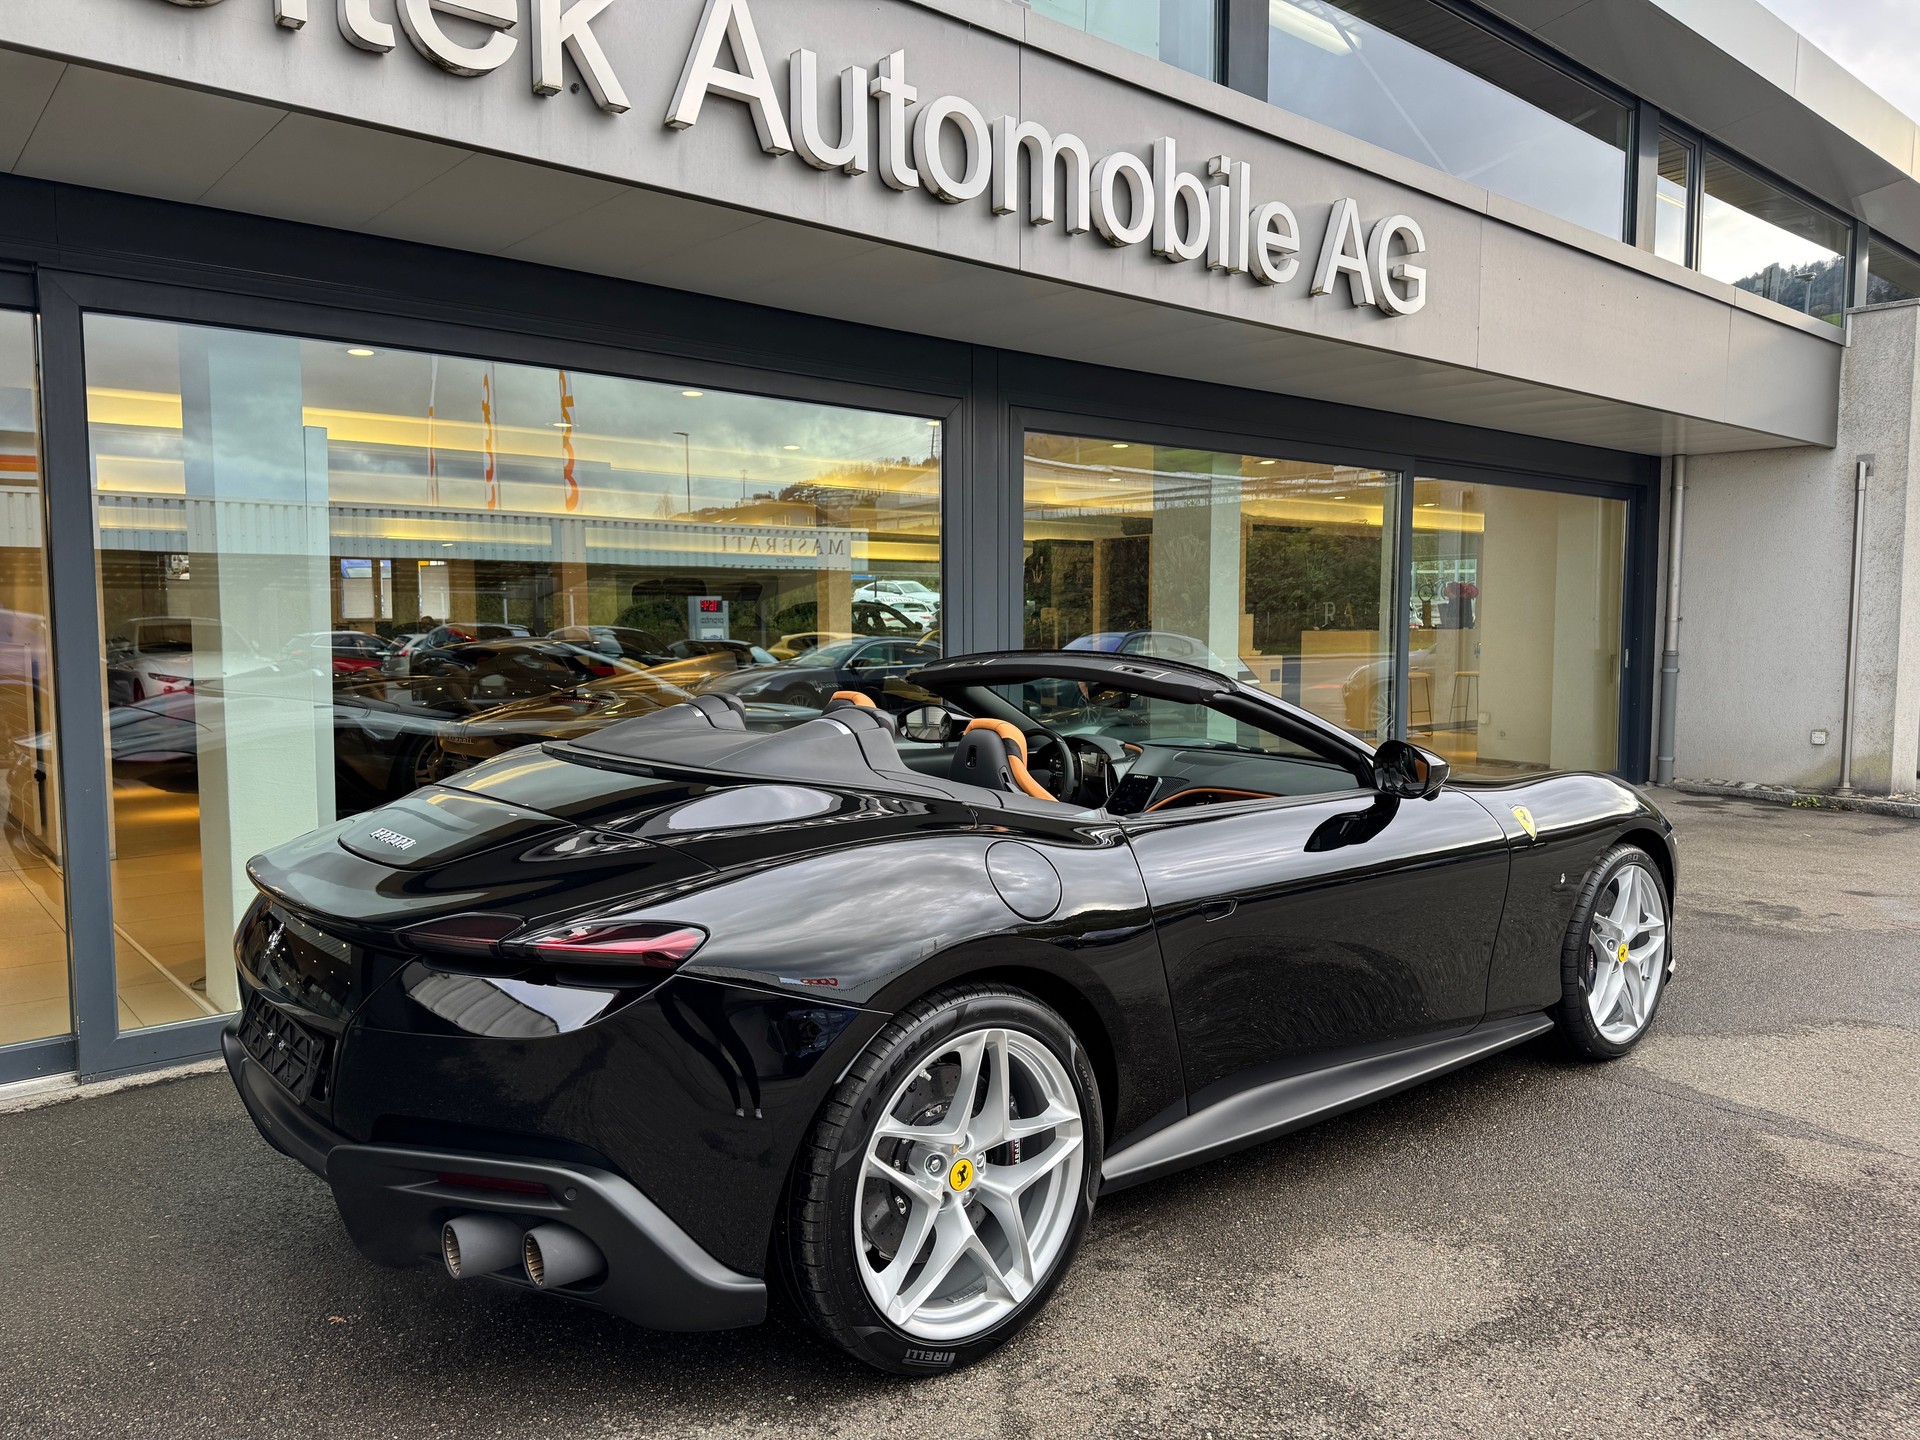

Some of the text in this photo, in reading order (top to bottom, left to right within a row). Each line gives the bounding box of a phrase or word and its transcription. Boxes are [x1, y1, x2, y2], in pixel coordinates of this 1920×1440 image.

[664, 0, 1300, 287] Automobile
[1310, 198, 1427, 317] AG
[875, 1025, 935, 1096] ZERO
[902, 1348, 956, 1368] PIRELLI
